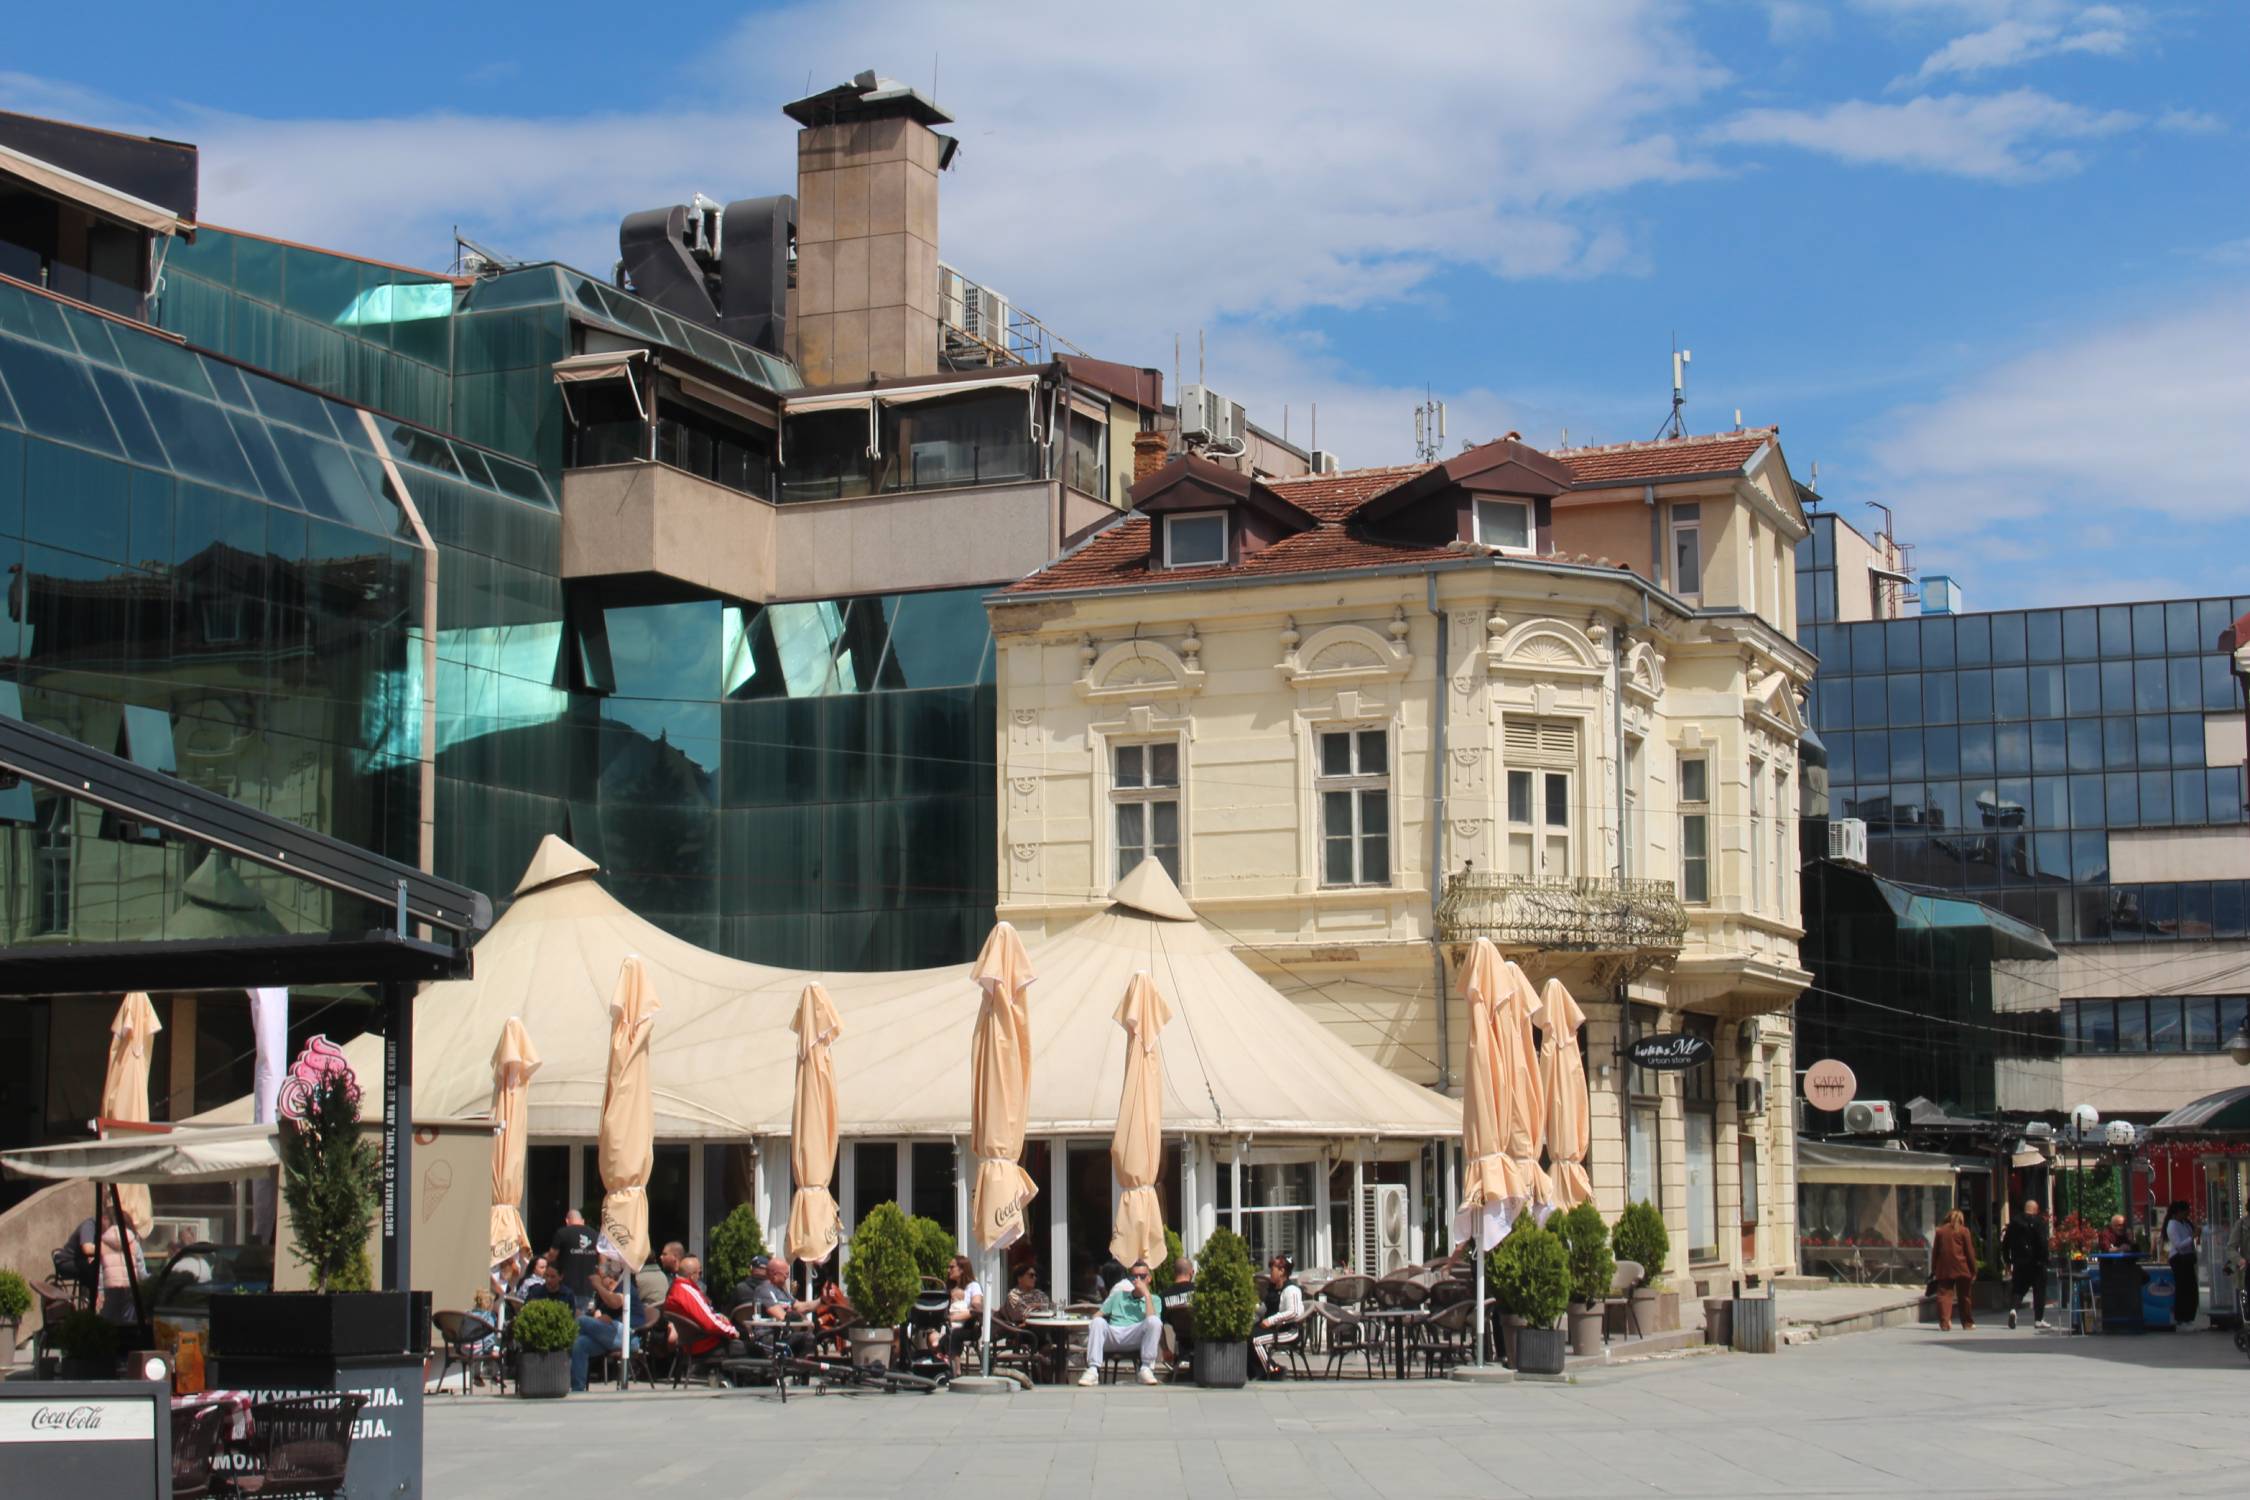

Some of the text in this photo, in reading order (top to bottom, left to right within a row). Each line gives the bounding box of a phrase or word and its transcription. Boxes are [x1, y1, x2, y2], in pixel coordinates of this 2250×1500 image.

[387, 1074, 396, 1086] СЕ
[386, 1104, 396, 1125] АМА
[386, 1167, 394, 1179] СЕ
[385, 1182, 394, 1236] ВИСТИНАТА
